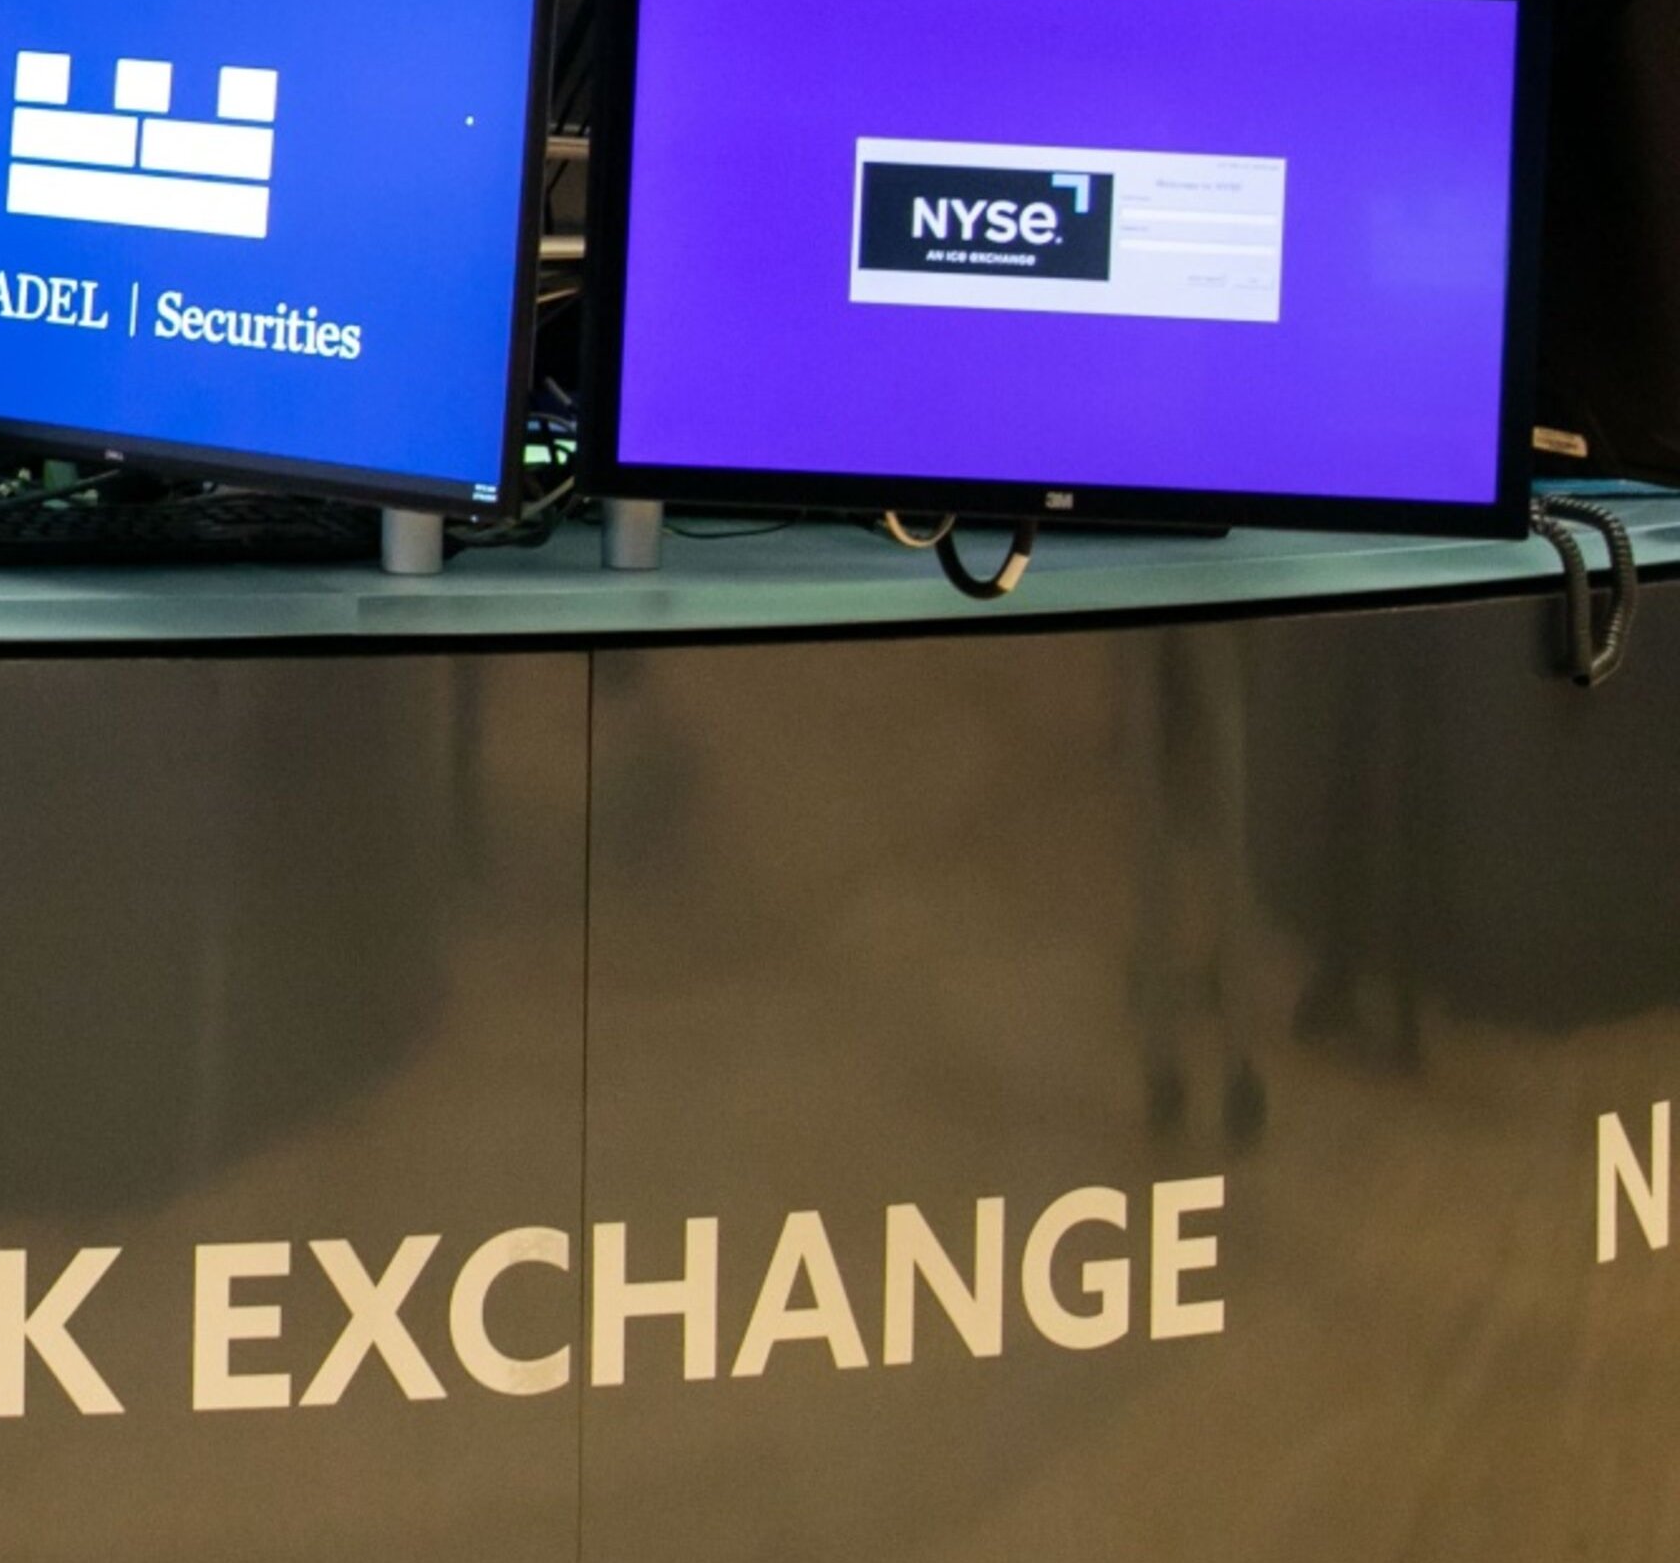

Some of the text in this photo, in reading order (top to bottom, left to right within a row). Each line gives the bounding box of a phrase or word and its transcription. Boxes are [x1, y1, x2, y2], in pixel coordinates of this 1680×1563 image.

[156, 292, 361, 358] Securities
[1045, 492, 1073, 509] 3M
[192, 1176, 1224, 1411] EXCHANGE
